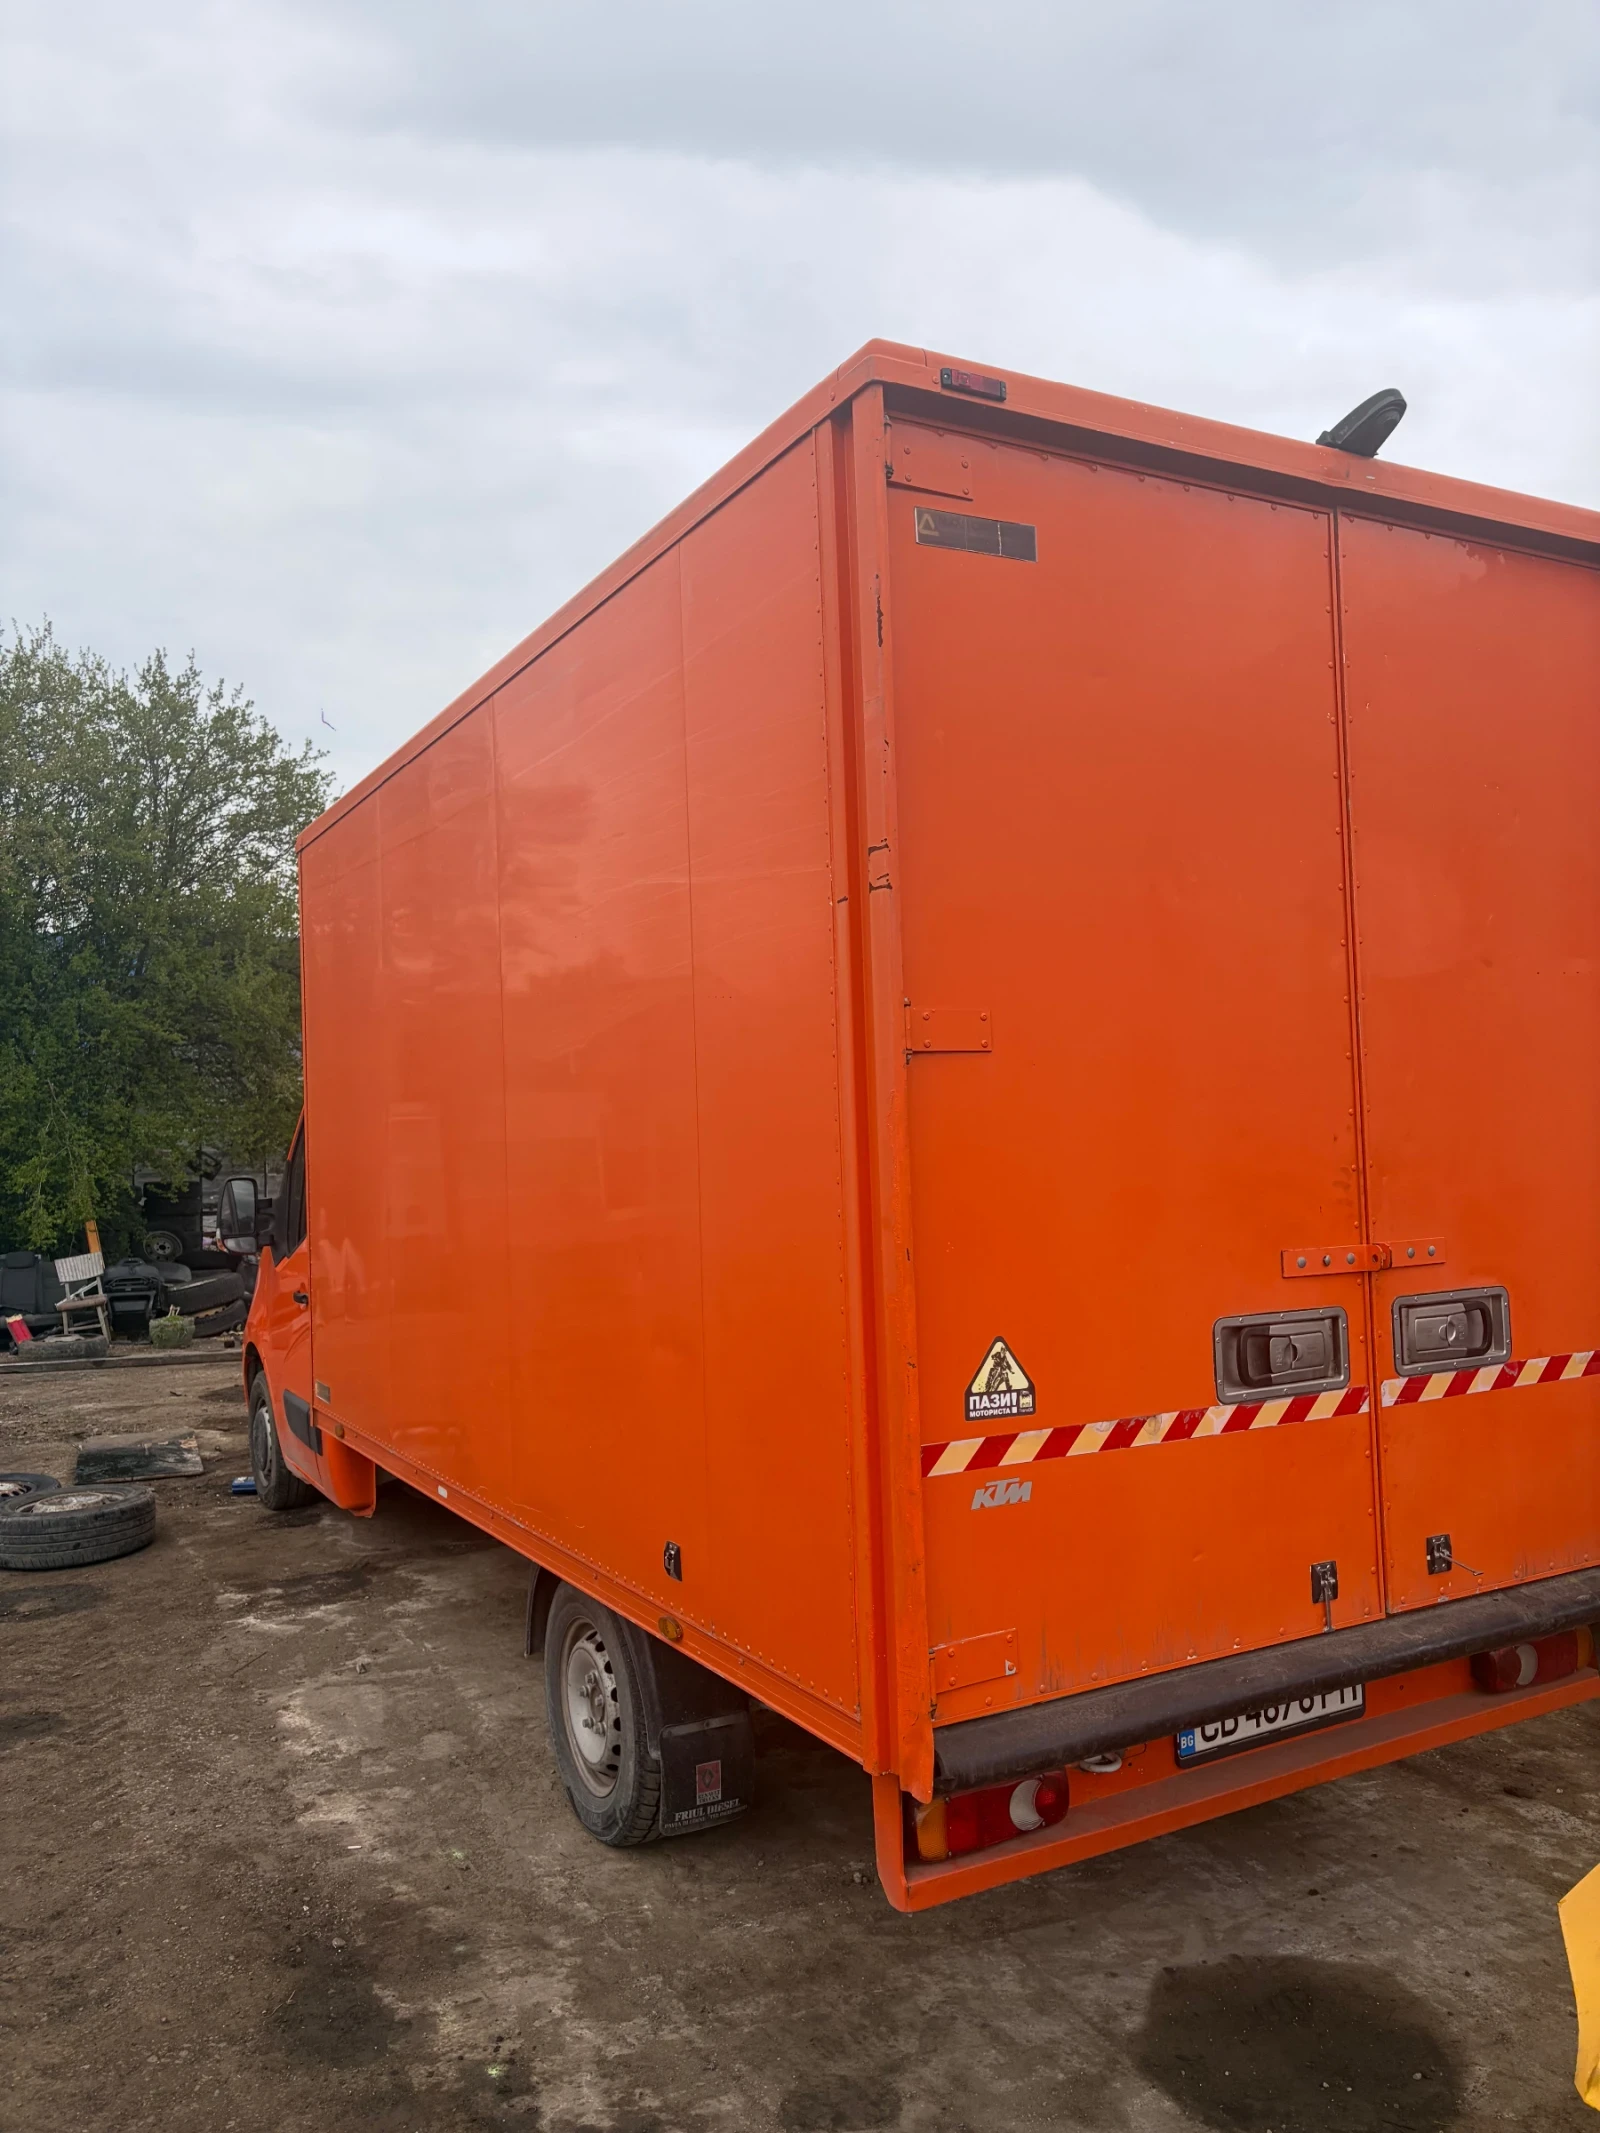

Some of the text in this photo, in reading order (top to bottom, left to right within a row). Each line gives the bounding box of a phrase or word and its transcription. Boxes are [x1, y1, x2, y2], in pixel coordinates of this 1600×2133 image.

[969, 1392, 1017, 1413] ПАЗИ!
[969, 1408, 1011, 1418] МОТОРИСТА
[971, 1477, 1032, 1510] KTM
[1180, 1734, 1194, 1749] BG
[675, 1807, 705, 1821] FRIUL
[707, 1798, 740, 1814] DIESEL
